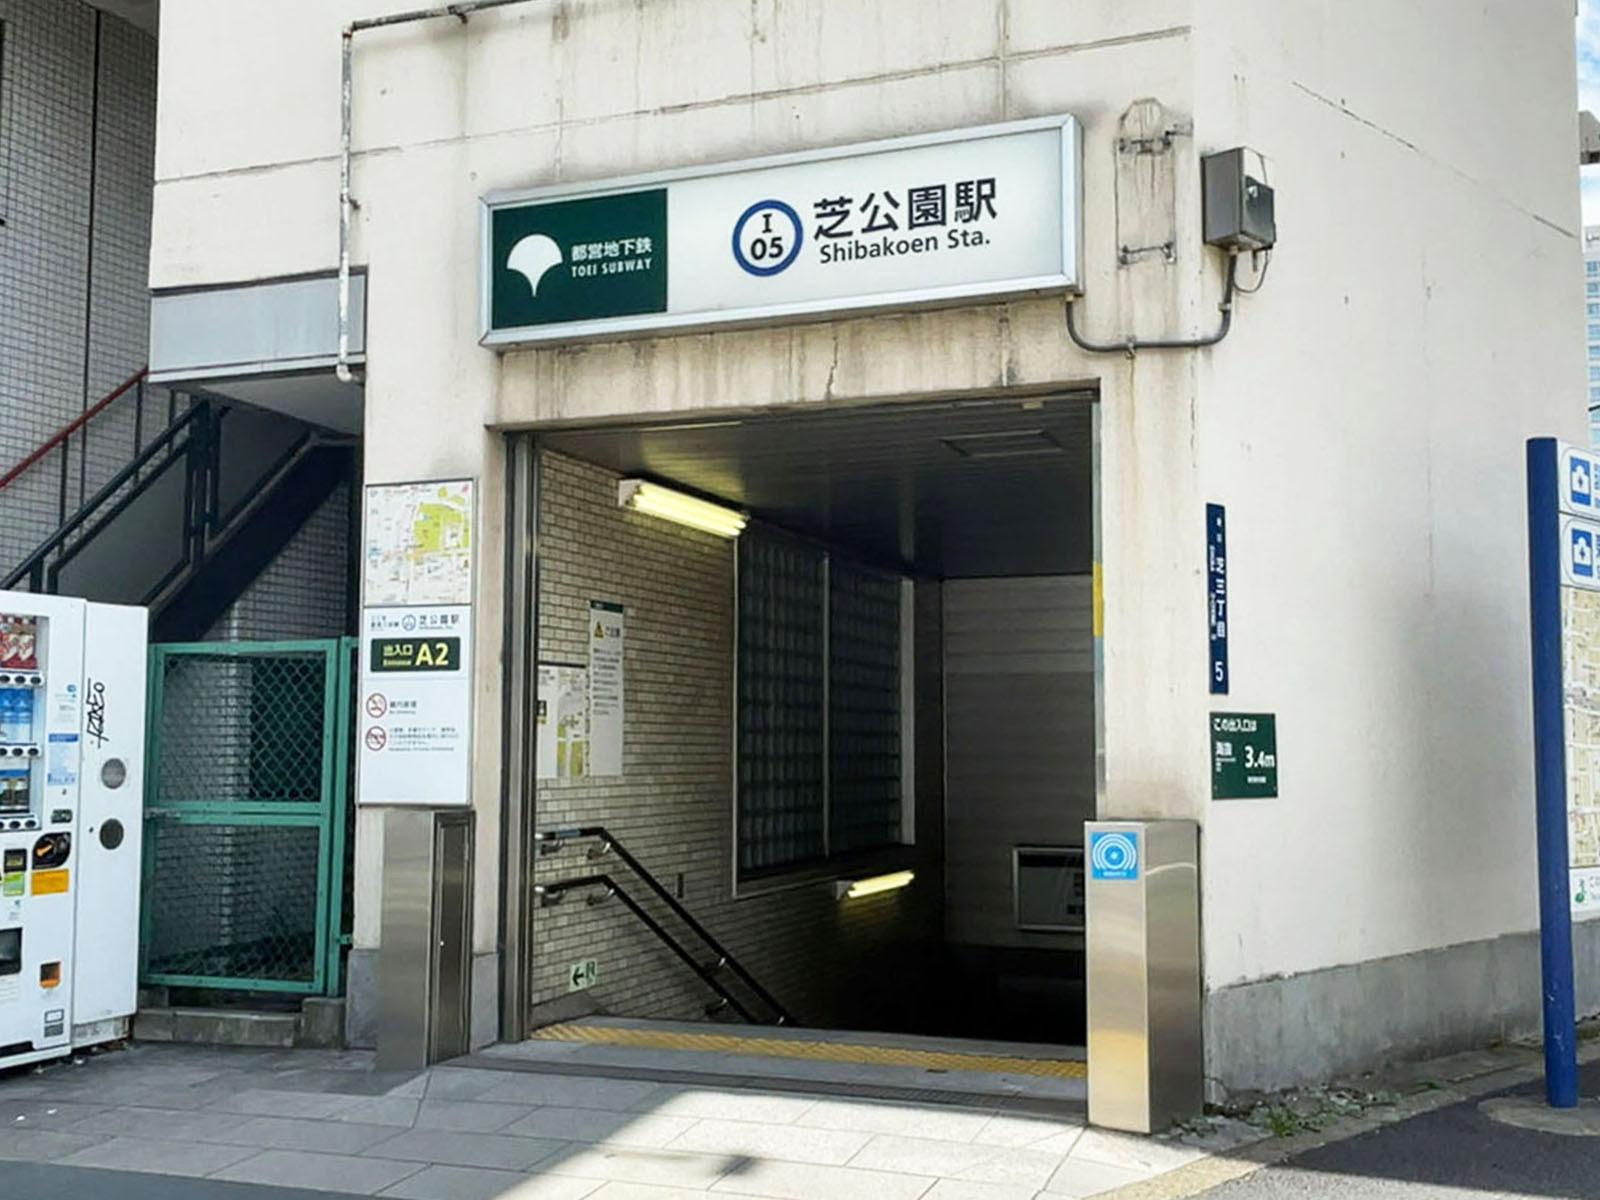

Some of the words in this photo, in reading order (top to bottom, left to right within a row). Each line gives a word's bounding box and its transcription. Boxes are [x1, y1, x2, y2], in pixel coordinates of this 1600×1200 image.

[814, 177, 997, 241] 芝公園駅
[761, 213, 772, 233] I
[571, 236, 652, 261] 都営地下鉄
[750, 237, 783, 261] 05
[820, 235, 938, 264] Shibakoen
[947, 228, 991, 249] Sta.
[571, 263, 597, 278] TOEI
[601, 257, 652, 275] SUBWAY
[415, 642, 449, 666] A2
[1214, 661, 1224, 682] 5
[1244, 745, 1275, 768] 3.4m
